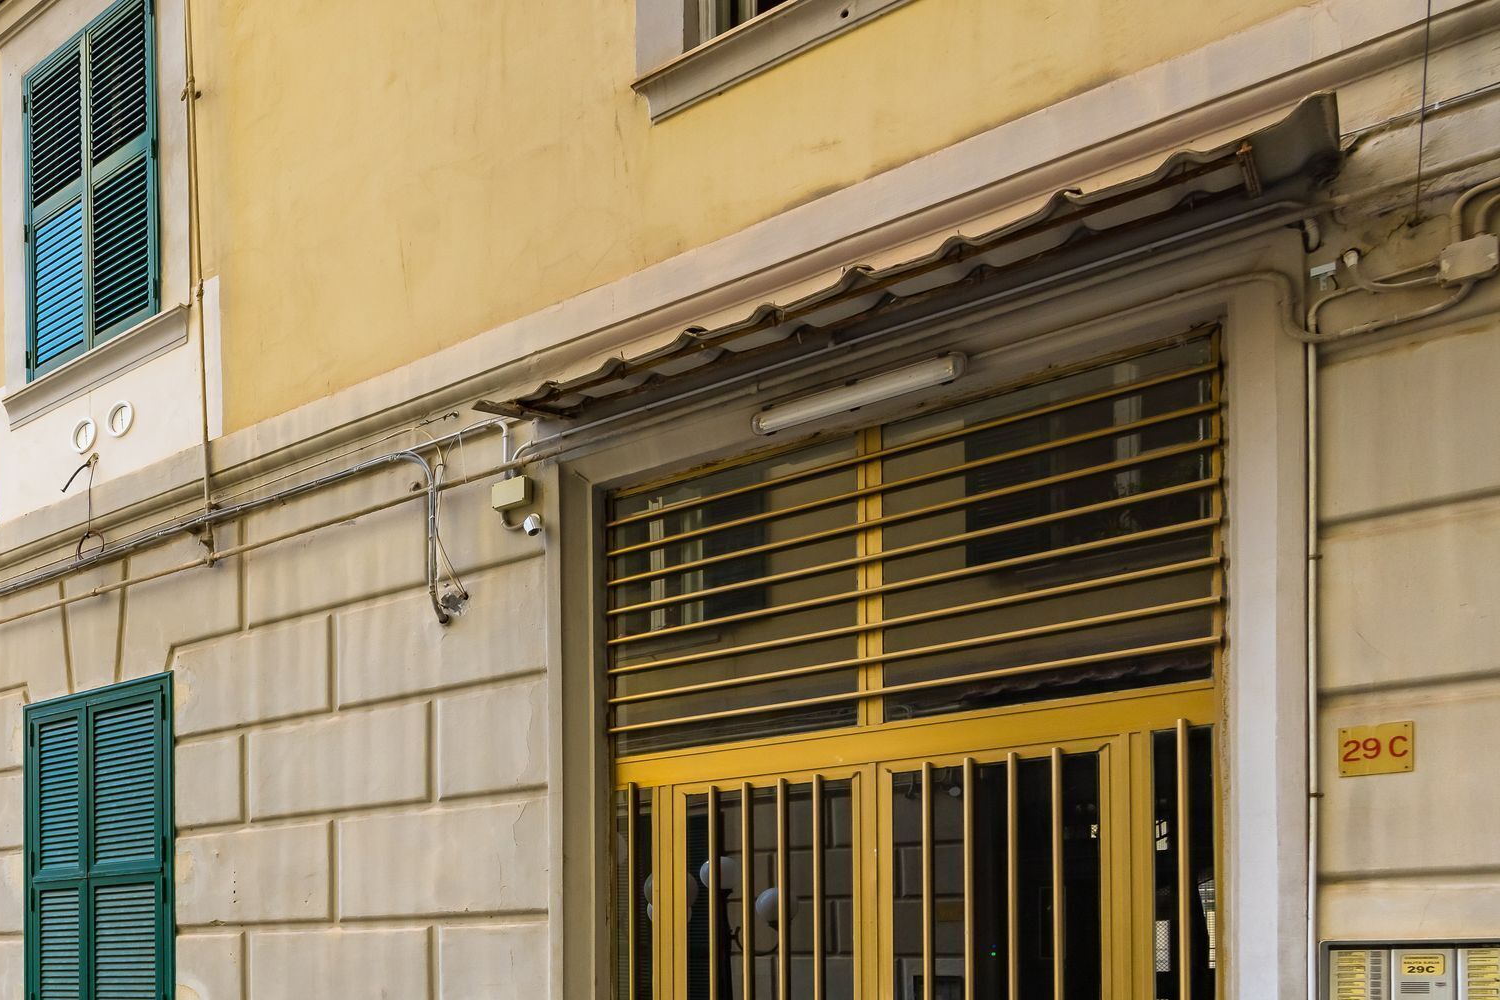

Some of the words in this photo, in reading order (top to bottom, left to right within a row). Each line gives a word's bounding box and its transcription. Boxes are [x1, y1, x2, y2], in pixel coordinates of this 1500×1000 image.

[1342, 736, 1381, 762] 29
[1389, 735, 1408, 757] C
[1407, 965, 1436, 974] 29C
